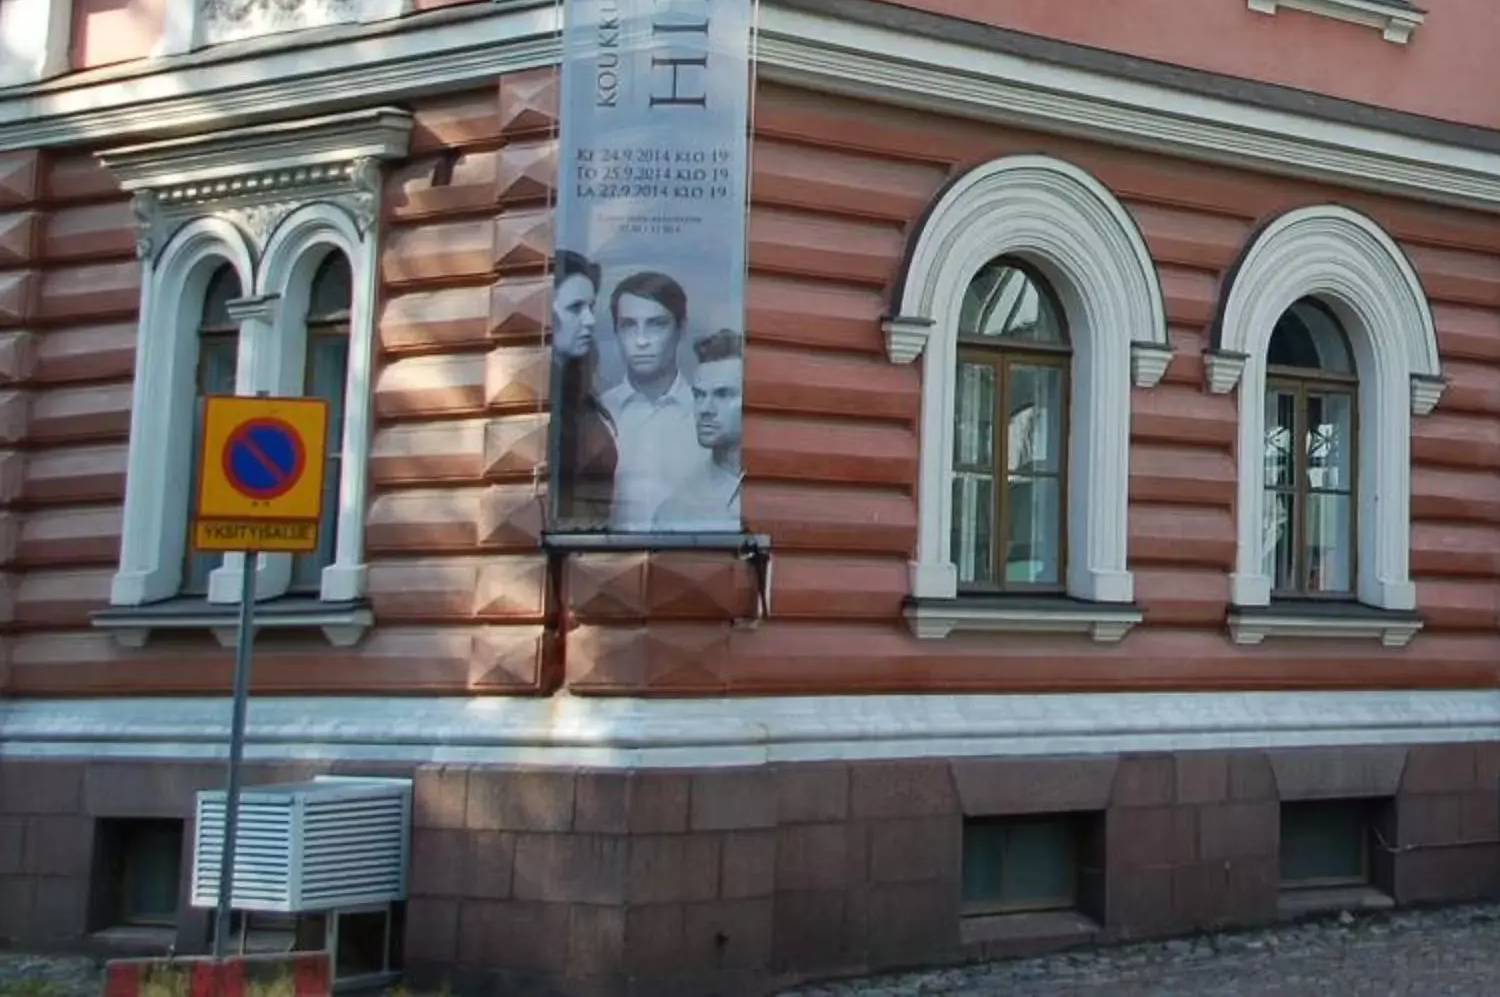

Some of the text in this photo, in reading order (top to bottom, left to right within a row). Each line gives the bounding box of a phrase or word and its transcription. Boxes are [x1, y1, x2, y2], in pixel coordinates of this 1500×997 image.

[675, 150, 705, 163] KLO
[713, 148, 729, 162] 19
[577, 166, 597, 180] TO
[676, 168, 706, 181] KLO
[713, 167, 729, 181] 19
[577, 184, 596, 198] LA
[674, 186, 704, 199] KLO
[710, 185, 727, 199] 19
